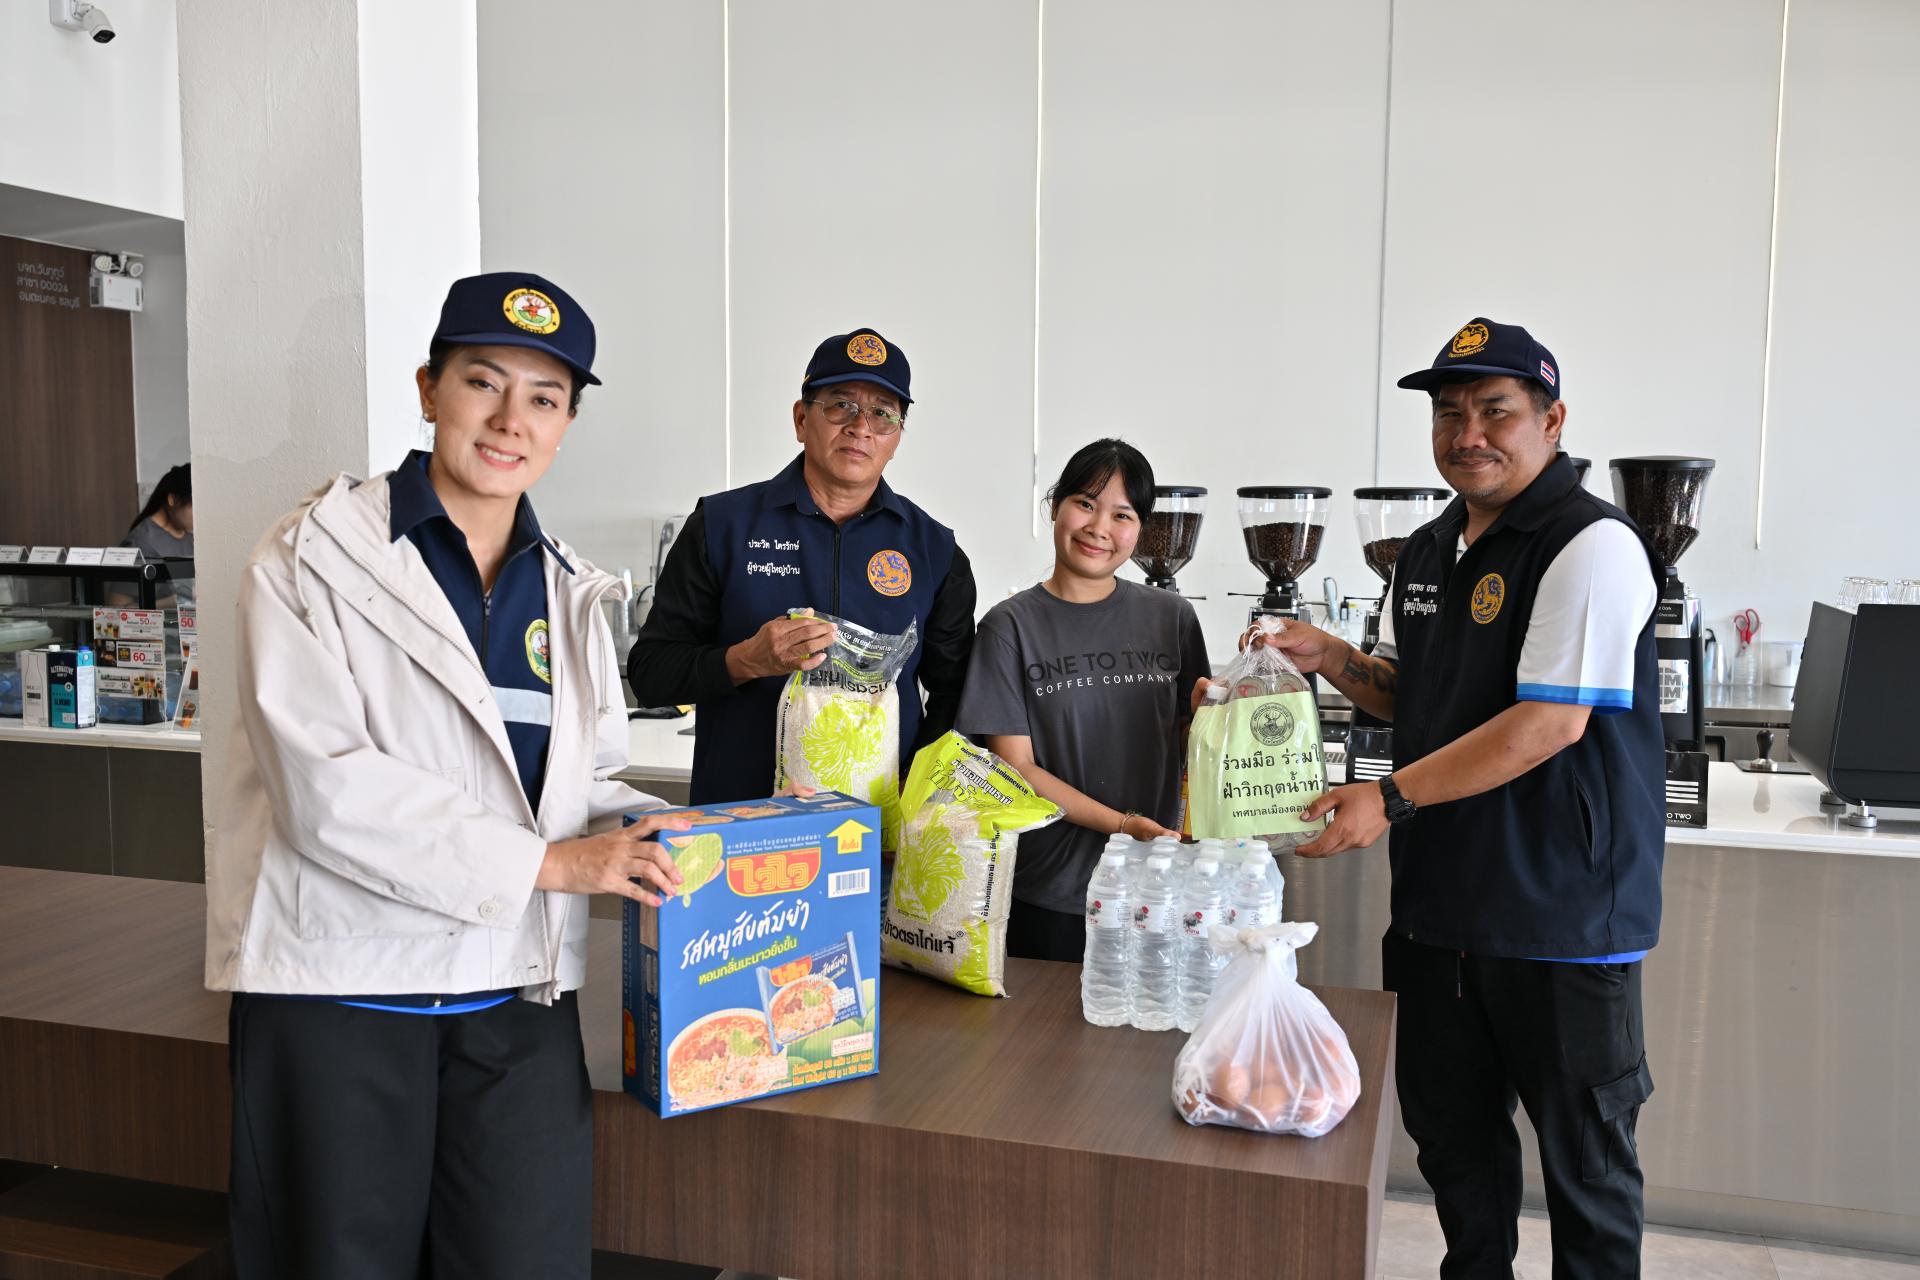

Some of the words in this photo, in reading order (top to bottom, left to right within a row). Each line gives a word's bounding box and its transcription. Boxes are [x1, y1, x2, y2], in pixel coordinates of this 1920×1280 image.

[747, 561, 800, 577] ผู้ช่วยผู้ใหญ่บ้าน
[180, 617, 194, 628] 50
[133, 652, 146, 662] 60
[1026, 655, 1078, 683] ONE
[1082, 652, 1117, 671] TO
[1122, 651, 1179, 672] TWO
[1036, 677, 1094, 697] COFFEE
[1103, 674, 1173, 685] COMPANY
[1223, 750, 1275, 771] ร่วมมือ
[1281, 743, 1321, 765] ร่วมใ
[1674, 812, 1692, 820] TWO
[730, 853, 809, 893] ไวไว
[680, 899, 810, 970] รสหมูสับต้มยำ
[883, 917, 956, 954] ข้าวตราไก่แจ้
[698, 935, 798, 986] หอมกลิ่นมะนาวยิ่งขึ้น
